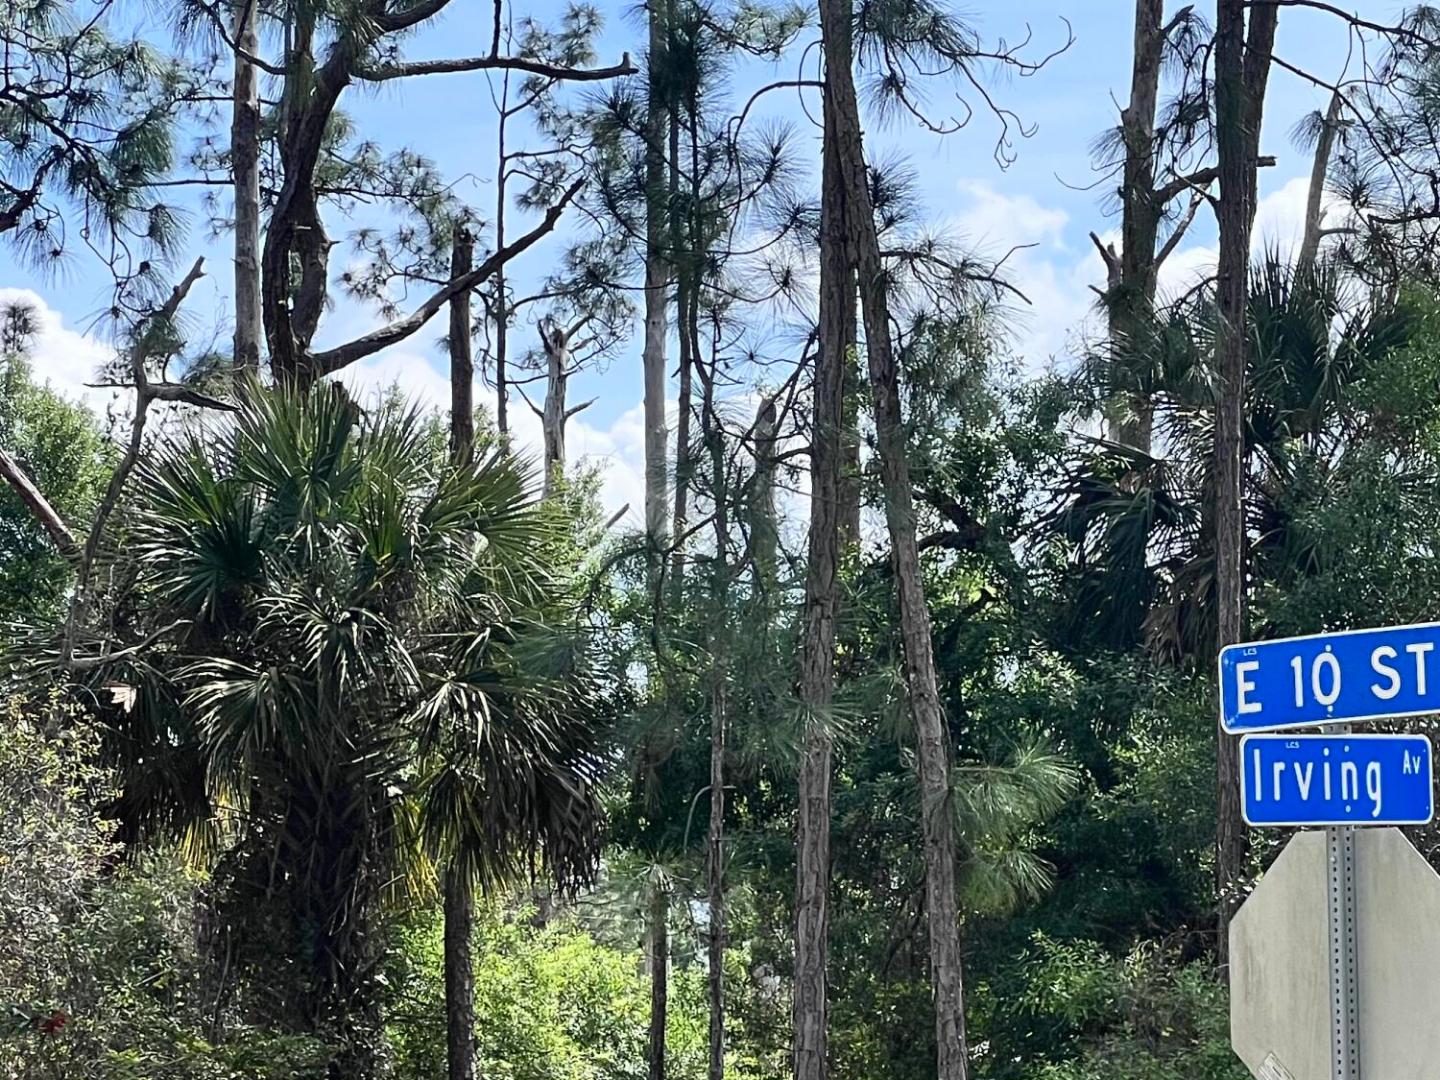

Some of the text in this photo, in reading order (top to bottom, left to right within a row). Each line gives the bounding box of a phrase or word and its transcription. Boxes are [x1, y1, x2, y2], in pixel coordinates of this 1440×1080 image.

[1235, 642, 1435, 714] E 10 ST
[1253, 747, 1421, 818] Irving Av
